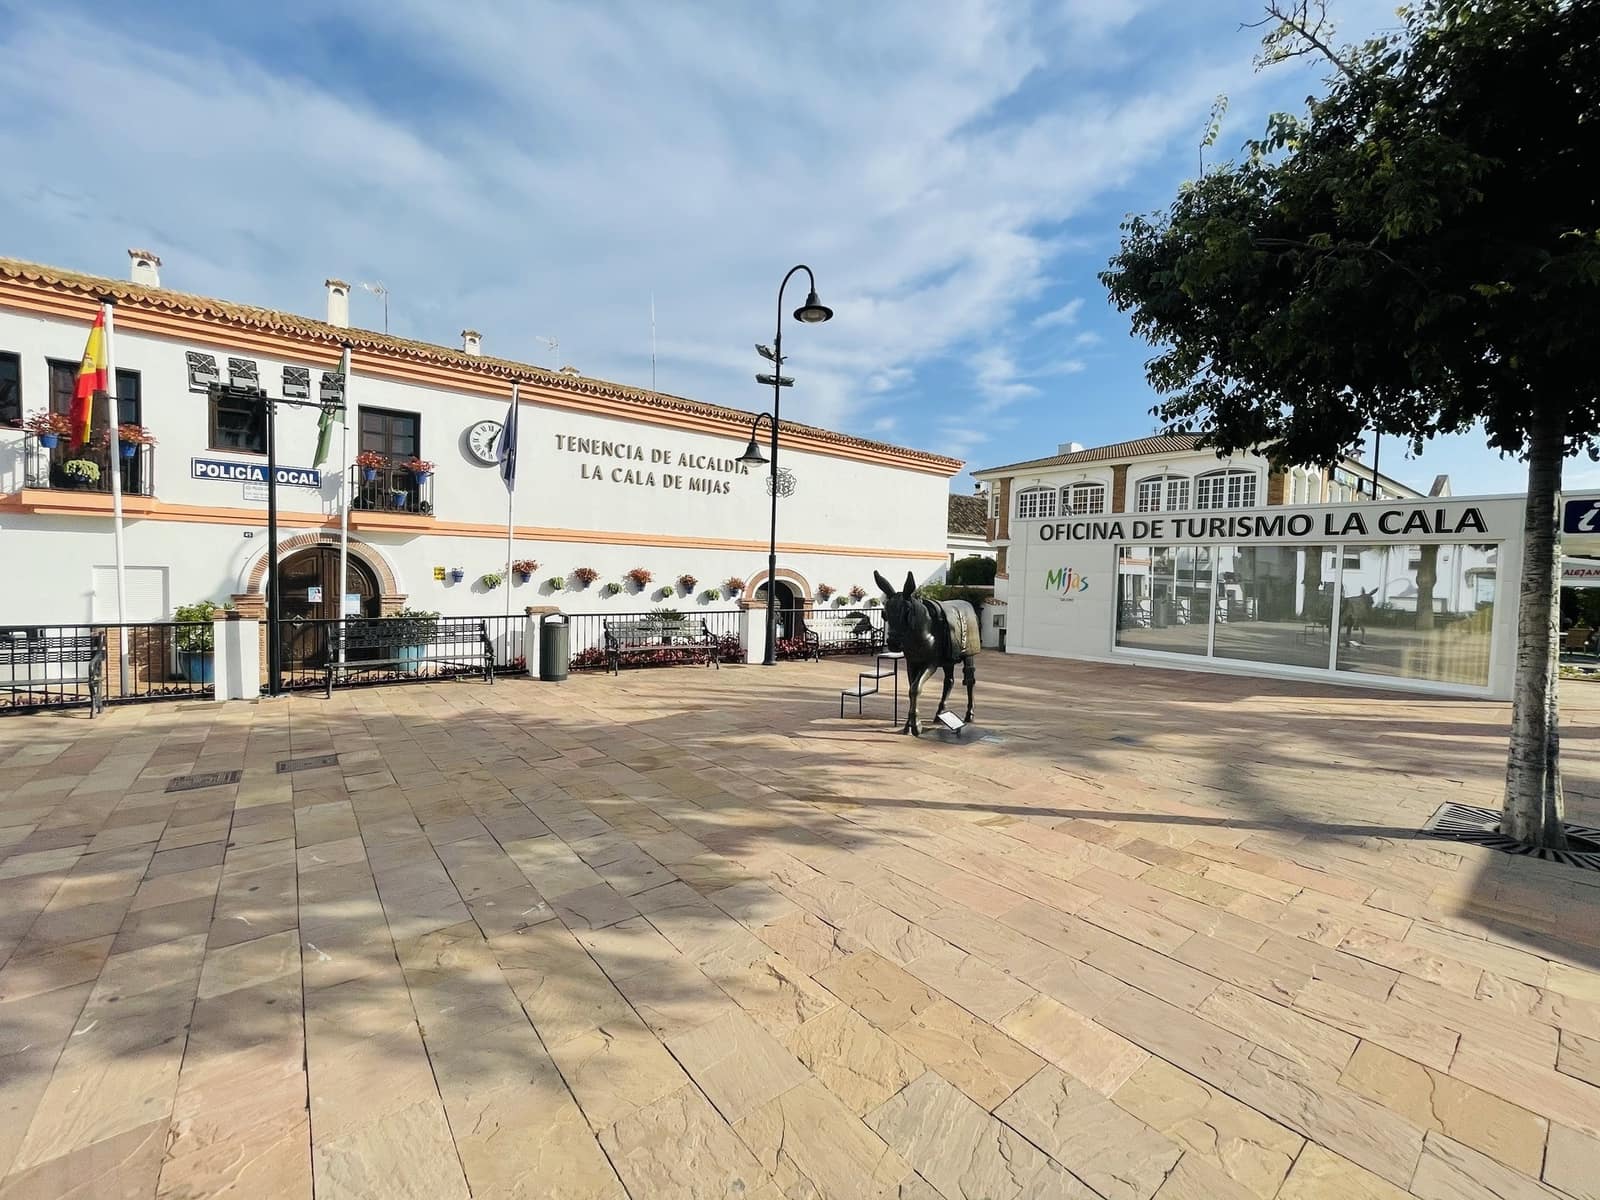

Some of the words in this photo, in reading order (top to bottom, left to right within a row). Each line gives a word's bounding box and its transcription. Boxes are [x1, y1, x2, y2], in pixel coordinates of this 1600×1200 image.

[555, 434, 644, 461] TENENCIA
[651, 449, 671, 464] DE
[196, 463, 264, 480] POLICÍA
[276, 471, 318, 485] OCAL
[581, 464, 603, 481] LA
[611, 468, 655, 487] CALA
[663, 474, 683, 490] DE
[688, 477, 730, 495] MIJAS
[1040, 521, 1126, 541] OFICINA
[1133, 520, 1164, 539] DE
[1171, 513, 1314, 538] TURISMO
[1325, 512, 1369, 535] LA
[1378, 508, 1488, 534] CALA
[1046, 567, 1088, 596] Mijas
